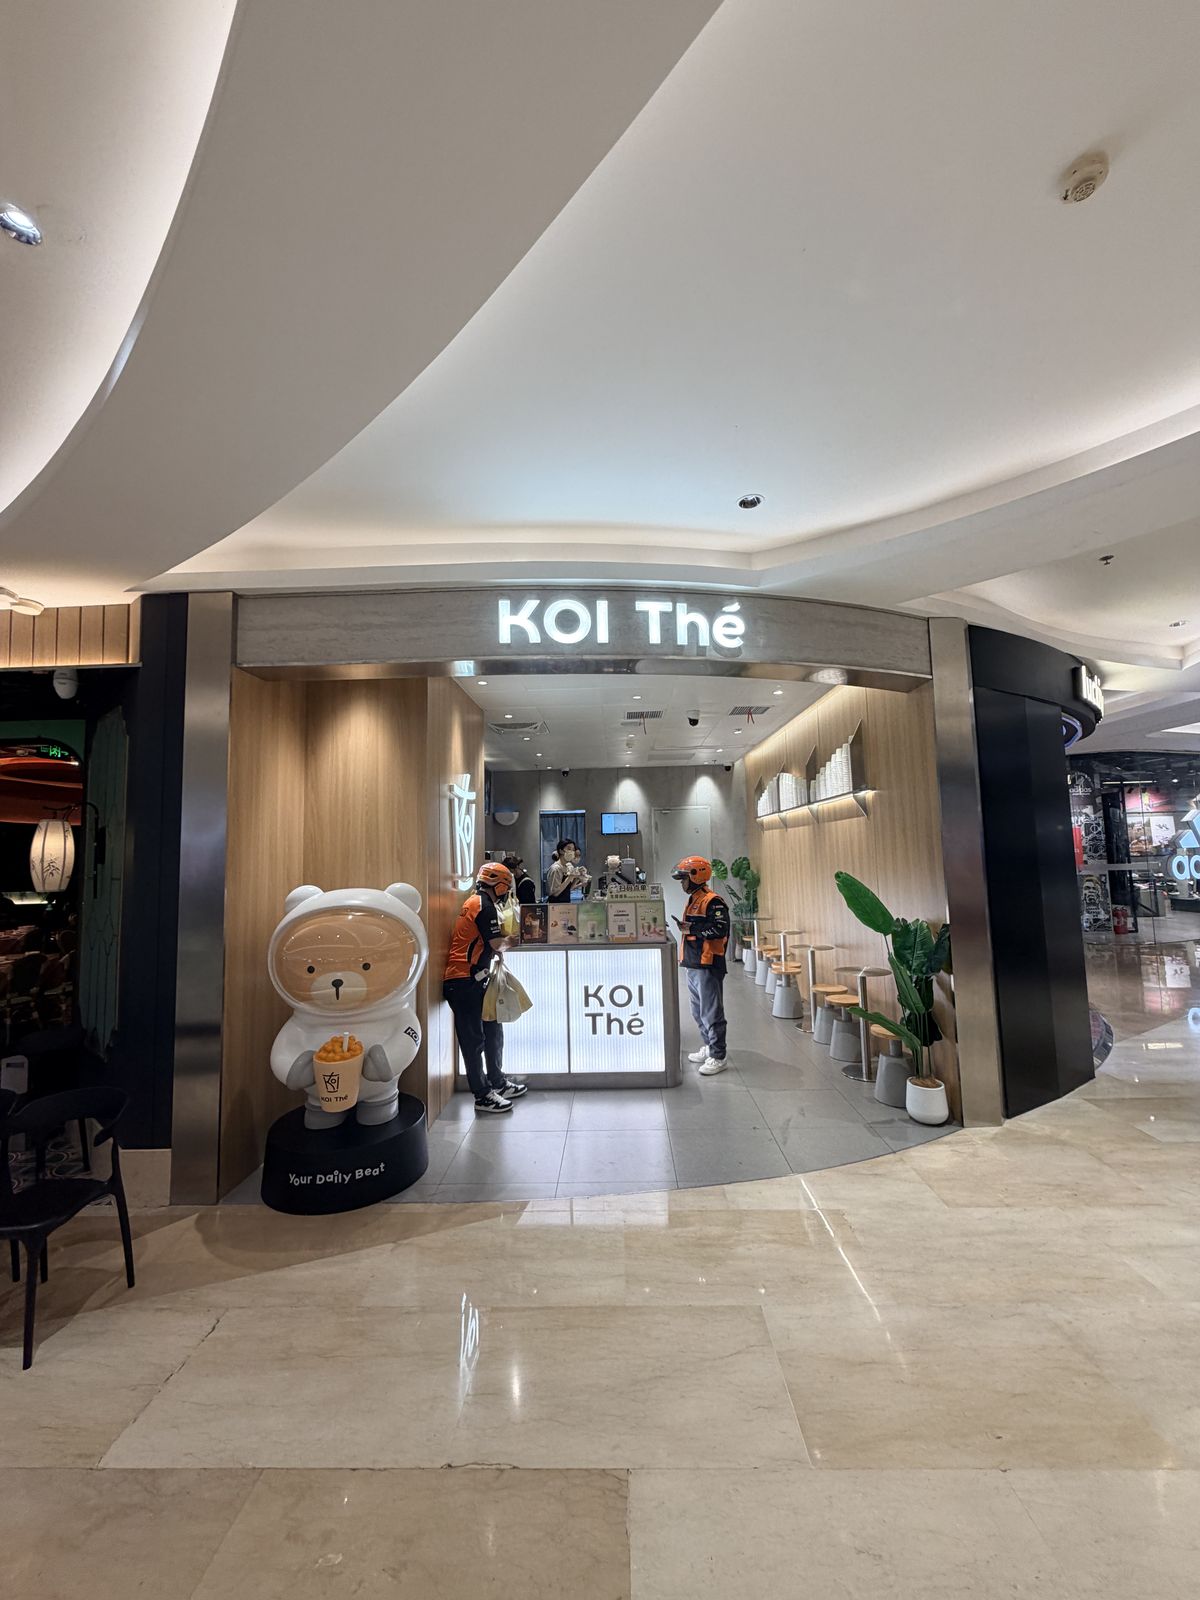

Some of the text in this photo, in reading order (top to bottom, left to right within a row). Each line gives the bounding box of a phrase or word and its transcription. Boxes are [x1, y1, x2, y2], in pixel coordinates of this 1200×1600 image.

[498, 599, 745, 648] KOI Thé
[584, 985, 644, 1007] KOI
[584, 1012, 644, 1035] Thé
[289, 1162, 385, 1186] Your Daily Beat
